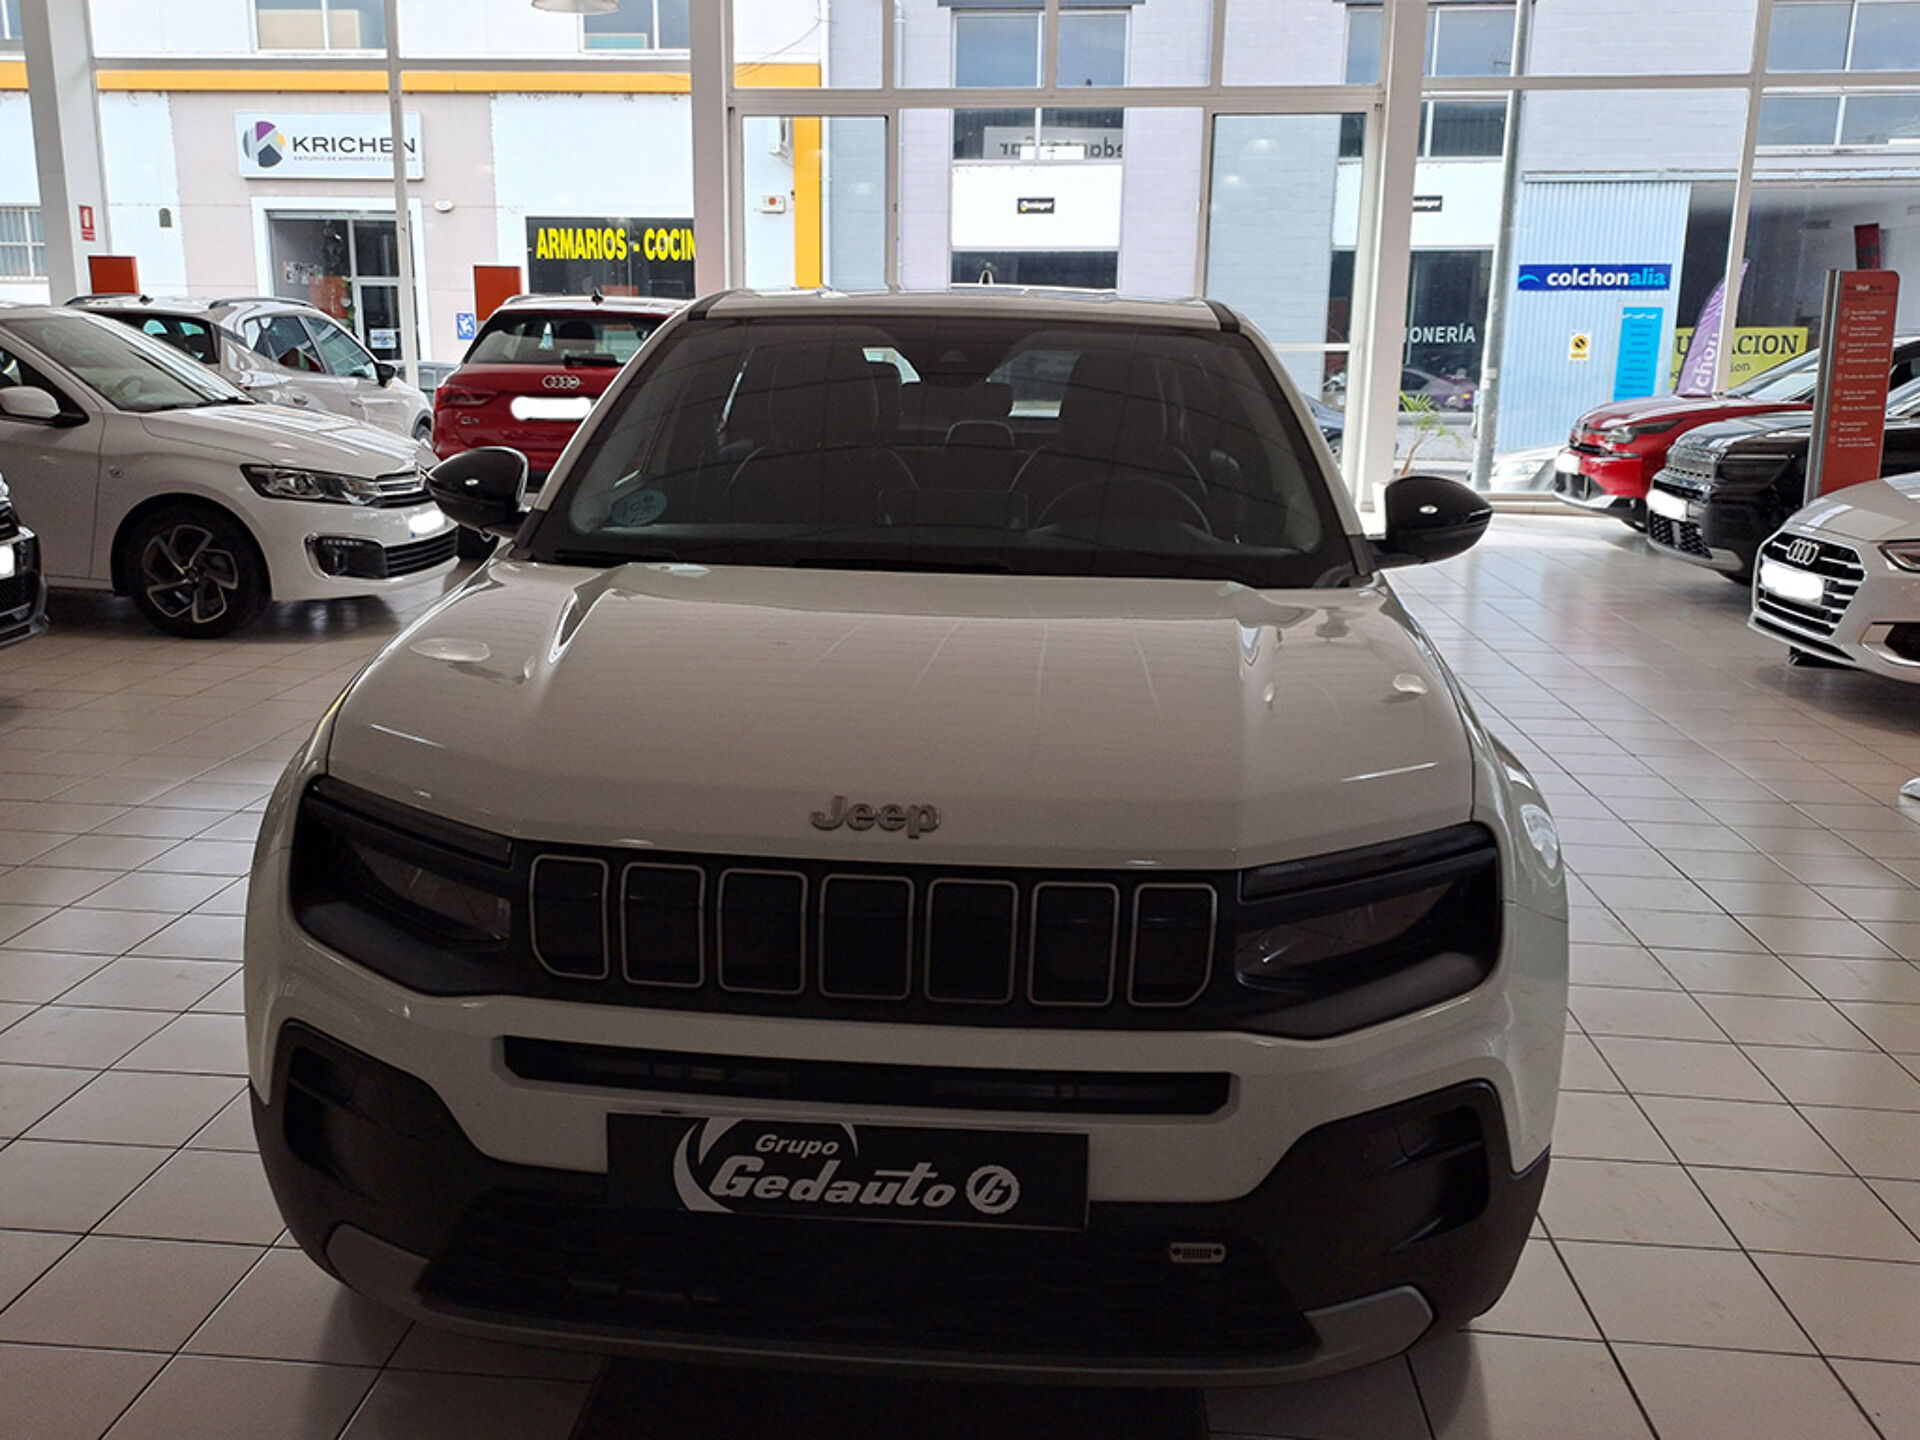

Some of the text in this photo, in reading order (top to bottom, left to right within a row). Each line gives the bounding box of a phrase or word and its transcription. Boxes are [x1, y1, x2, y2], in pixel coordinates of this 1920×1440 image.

[292, 136, 416, 153] KRICHEN
[536, 227, 627, 260] ARMARIOS
[1546, 267, 1666, 287] colchonalia
[808, 795, 942, 839] Jeep
[755, 1133, 839, 1156] Grupo
[708, 1155, 956, 1208] Gedauto
